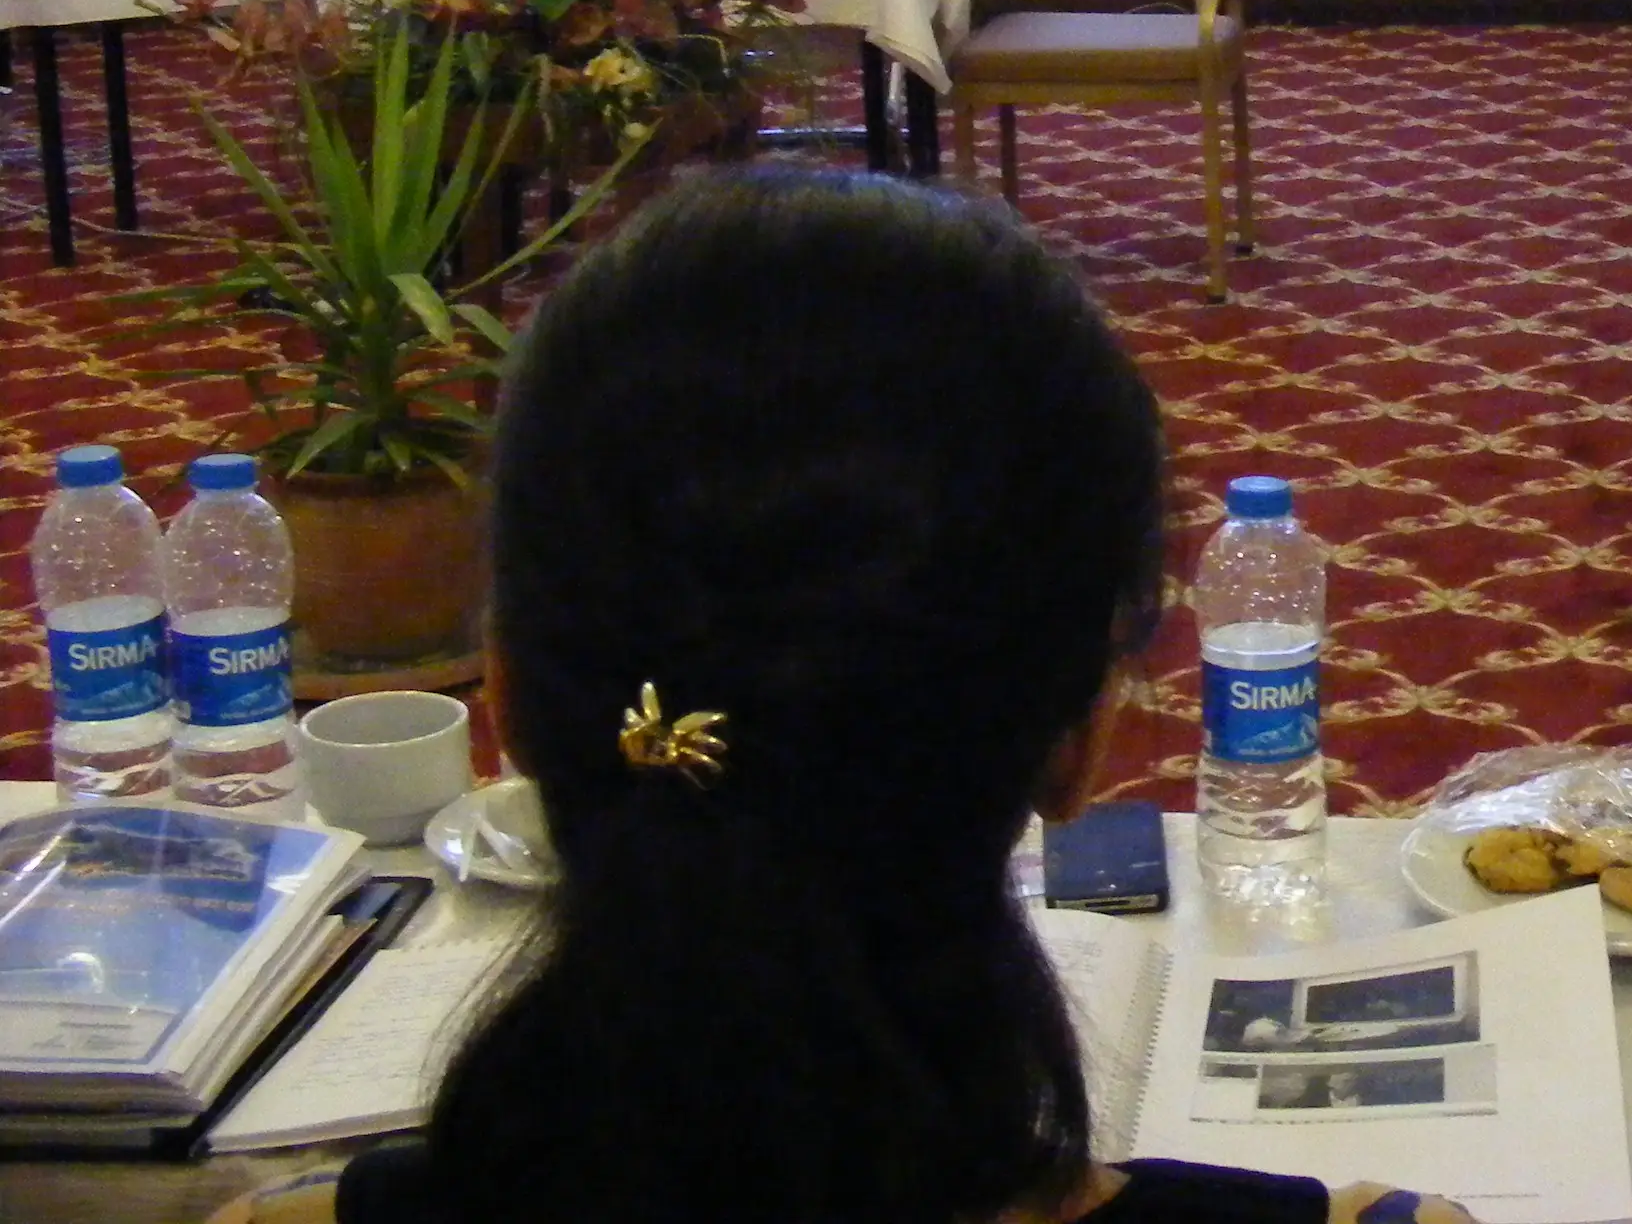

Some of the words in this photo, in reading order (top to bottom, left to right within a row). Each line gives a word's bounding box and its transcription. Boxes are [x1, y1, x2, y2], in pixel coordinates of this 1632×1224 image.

[68, 635, 156, 671] SIRMA
[209, 636, 290, 675] SIRMA
[1229, 676, 1316, 710] SIRMA
